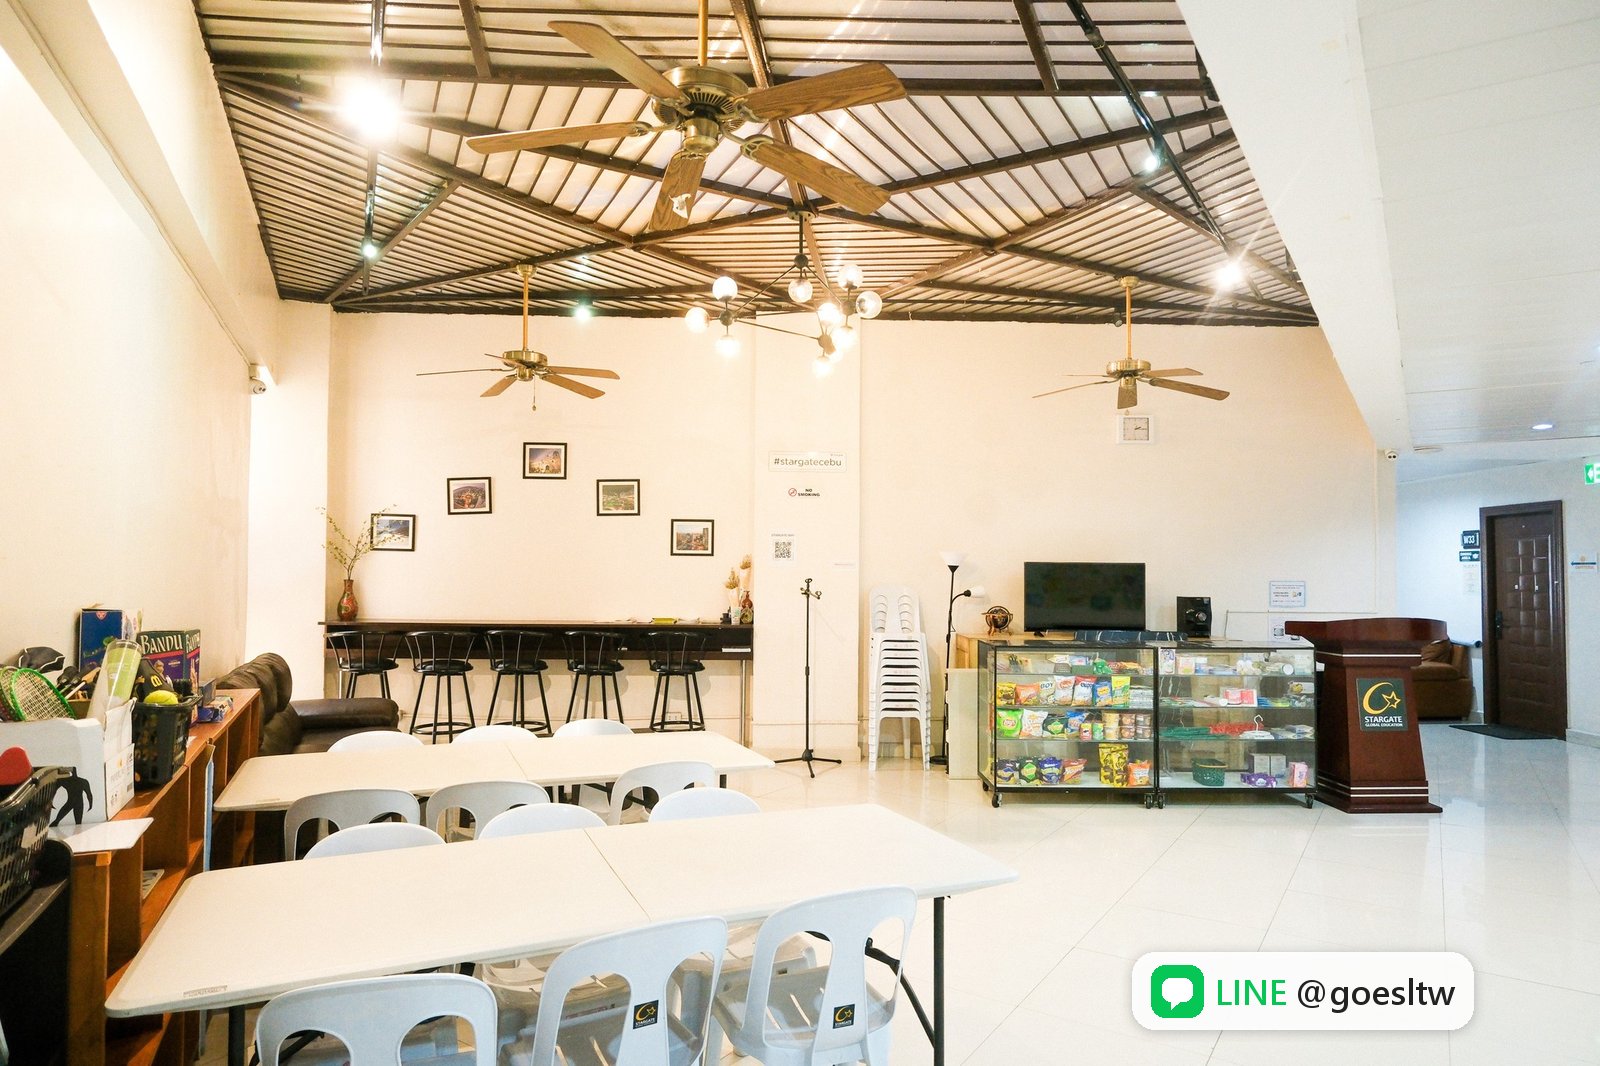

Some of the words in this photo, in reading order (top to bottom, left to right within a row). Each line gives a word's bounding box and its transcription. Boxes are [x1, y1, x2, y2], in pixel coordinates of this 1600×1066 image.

[774, 458, 842, 467] #stargatecebu
[140, 634, 183, 655] BANDU
[1364, 715, 1403, 723] STARGATE
